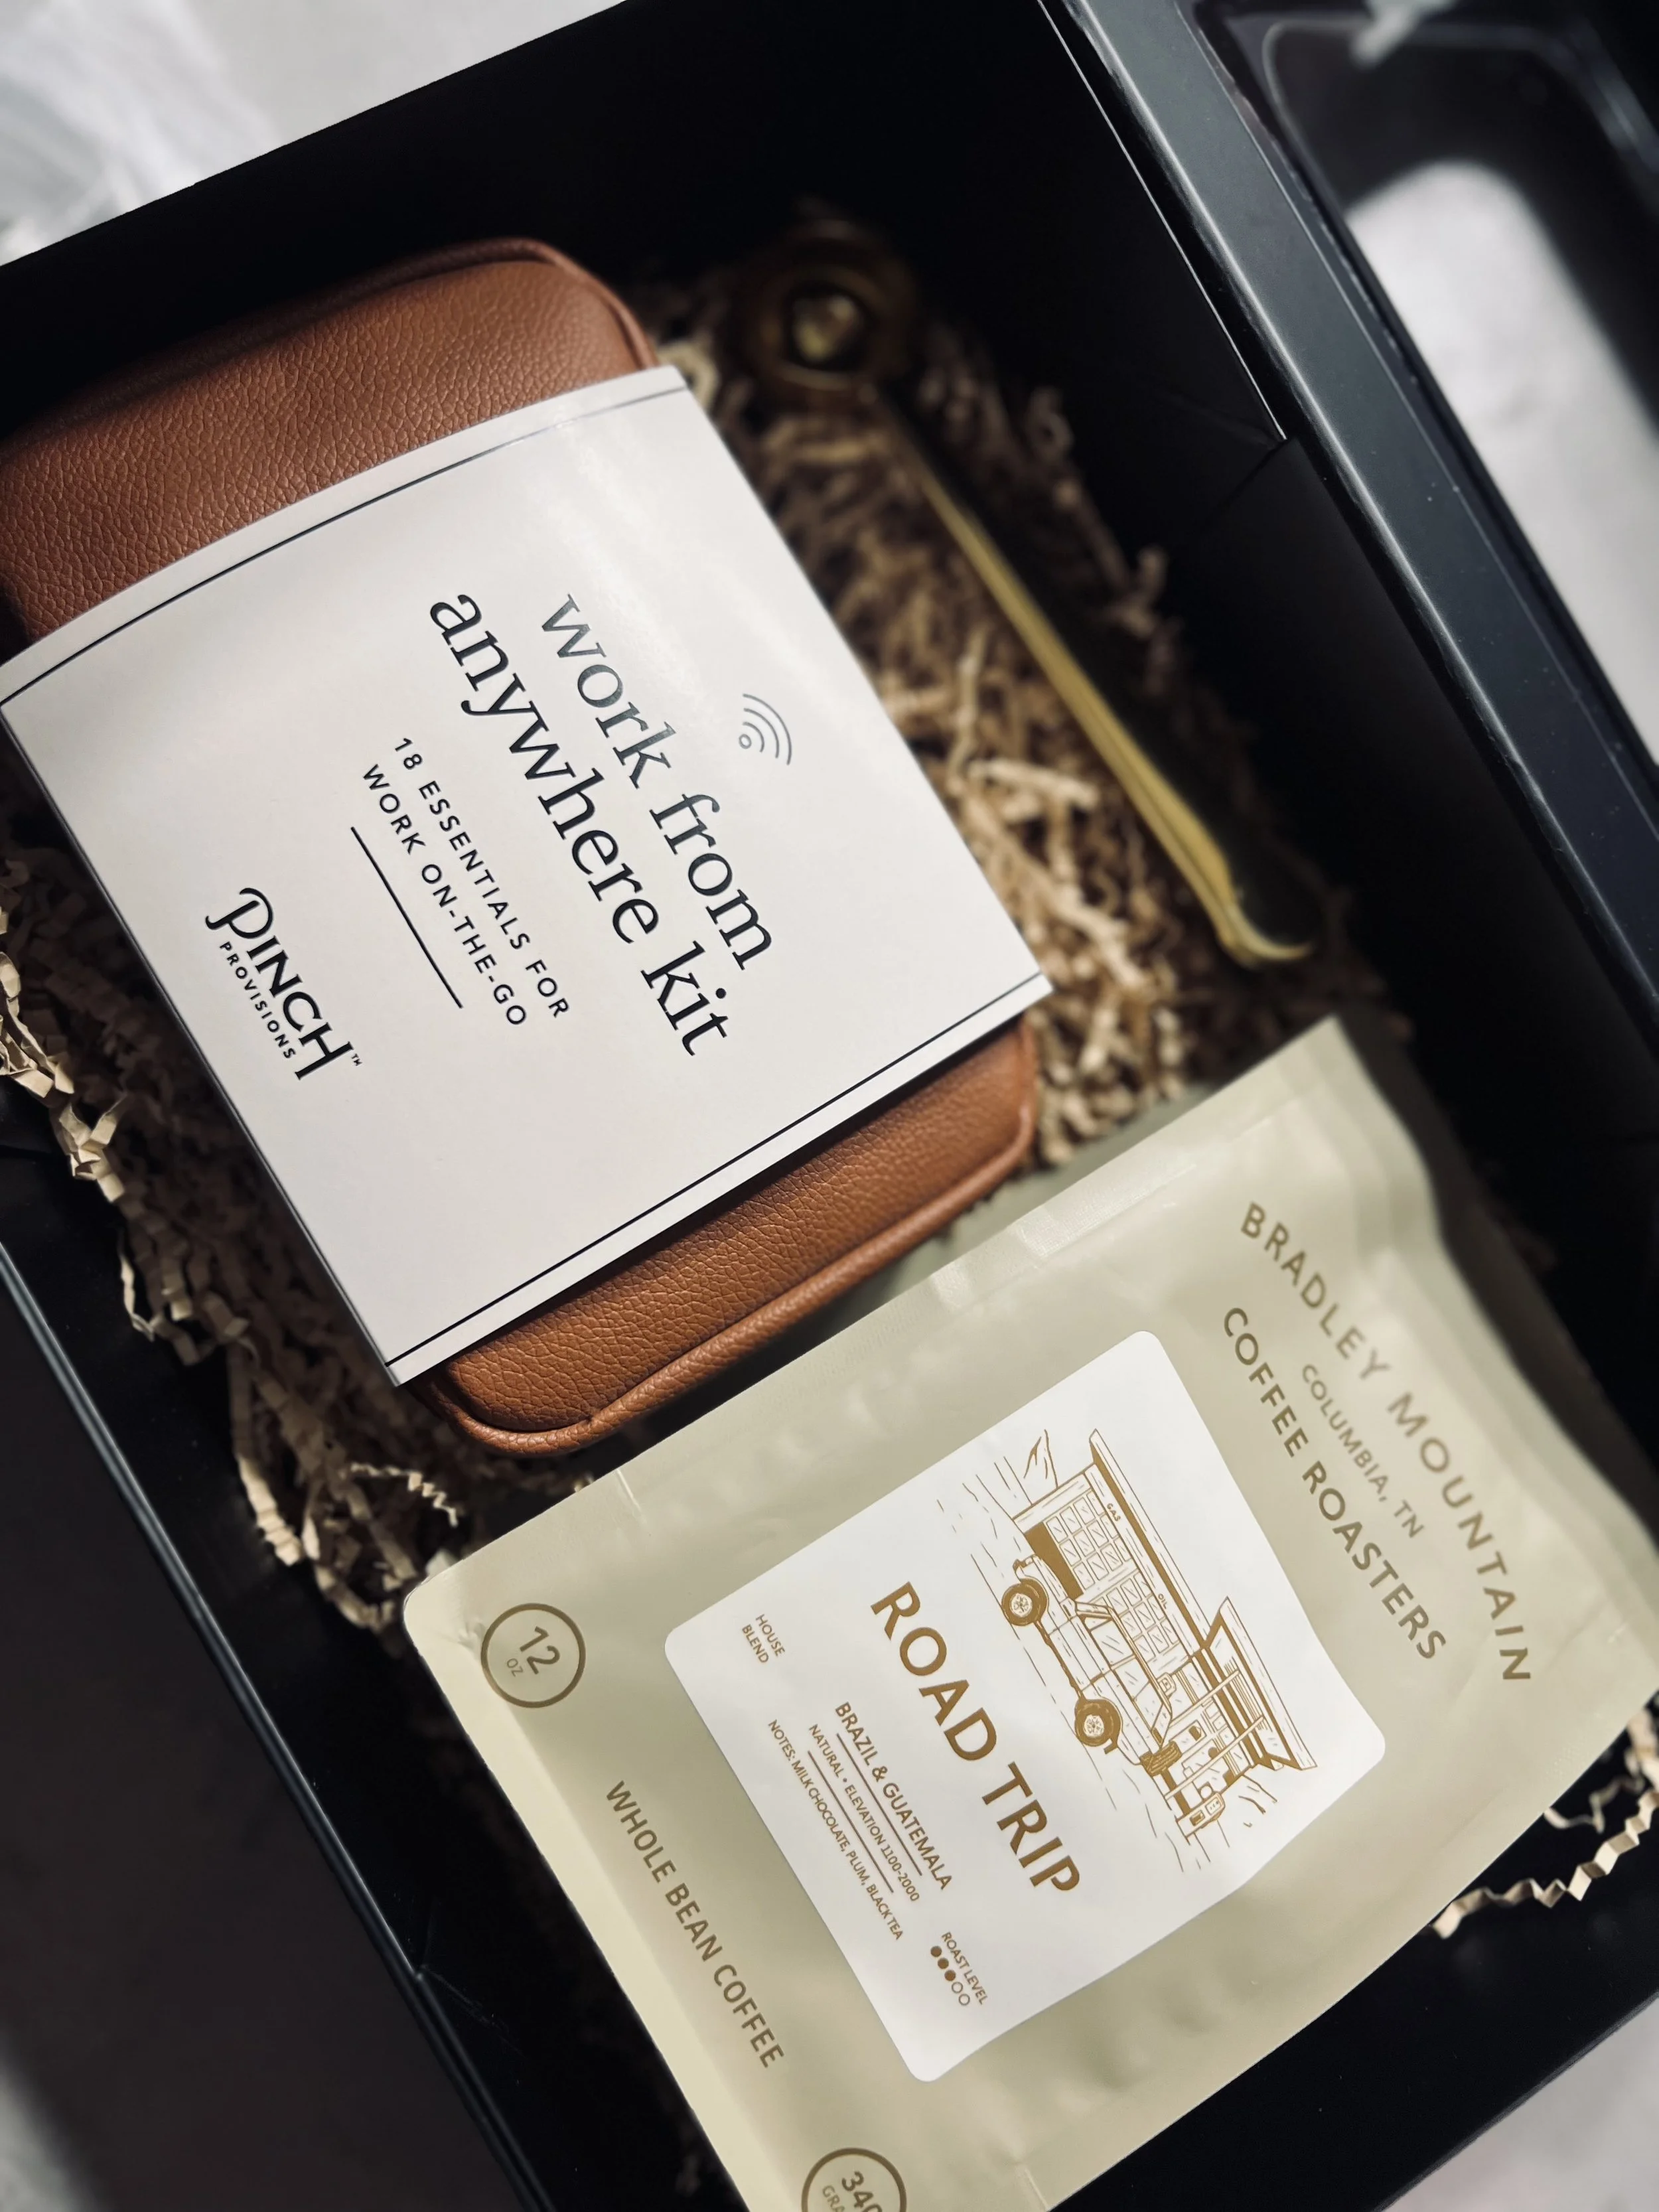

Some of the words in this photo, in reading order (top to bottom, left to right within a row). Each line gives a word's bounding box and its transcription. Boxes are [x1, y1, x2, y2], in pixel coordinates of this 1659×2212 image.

[431, 594, 659, 943] anywhere
[640, 940, 729, 1056] kit
[541, 594, 676, 788] work
[649, 793, 772, 970] from
[363, 764, 426, 855] WORK
[421, 863, 526, 1025] ON-THE-GO
[394, 738, 423, 770] 18
[419, 780, 530, 949] ESSENTIALS
[525, 960, 569, 1017] FOR
[220, 942, 296, 1059] PROVISIONS
[1107, 1503, 1121, 1522] GAS
[1224, 1307, 1308, 1457] COFFEE
[1302, 1461, 1446, 1659] ROASTERS
[1240, 1201, 1390, 1380] BRADLEY
[1388, 1392, 1530, 1680] MOUNTAIN
[1302, 1364, 1390, 1501] COLUMBIA,
[1393, 1500, 1424, 1538] TN
[506, 1657, 524, 1678] OZ
[519, 1626, 561, 1675] 12
[742, 1625, 768, 1664] BLEND
[755, 1614, 785, 1656] HOUSE
[1157, 1593, 1167, 1609] OIL
[809, 1724, 844, 1778] NATURAL
[844, 1785, 885, 1846] ELEVATION
[881, 1844, 920, 1901] 1100-2000
[835, 1702, 877, 1765] BRAZIL
[872, 1765, 889, 1782] &
[883, 1783, 953, 1890] GUATEMALA
[870, 1581, 997, 1761] ROAD
[981, 1761, 1080, 1891] TRIP
[768, 1720, 796, 1761] NOTES:
[792, 1760, 814, 1789] MILK
[807, 1787, 849, 1853] CHOCOLATE,
[845, 1851, 869, 1887] PLUM,
[865, 1883, 893, 1926] BLACK
[887, 1920, 904, 1940] TEA
[606, 1781, 676, 1884] WHOLE
[664, 1881, 723, 1962] BEAN
[713, 1964, 784, 2069] COFFEE
[942, 1932, 972, 1973] ROAST
[965, 1969, 988, 2006] LEVEL
